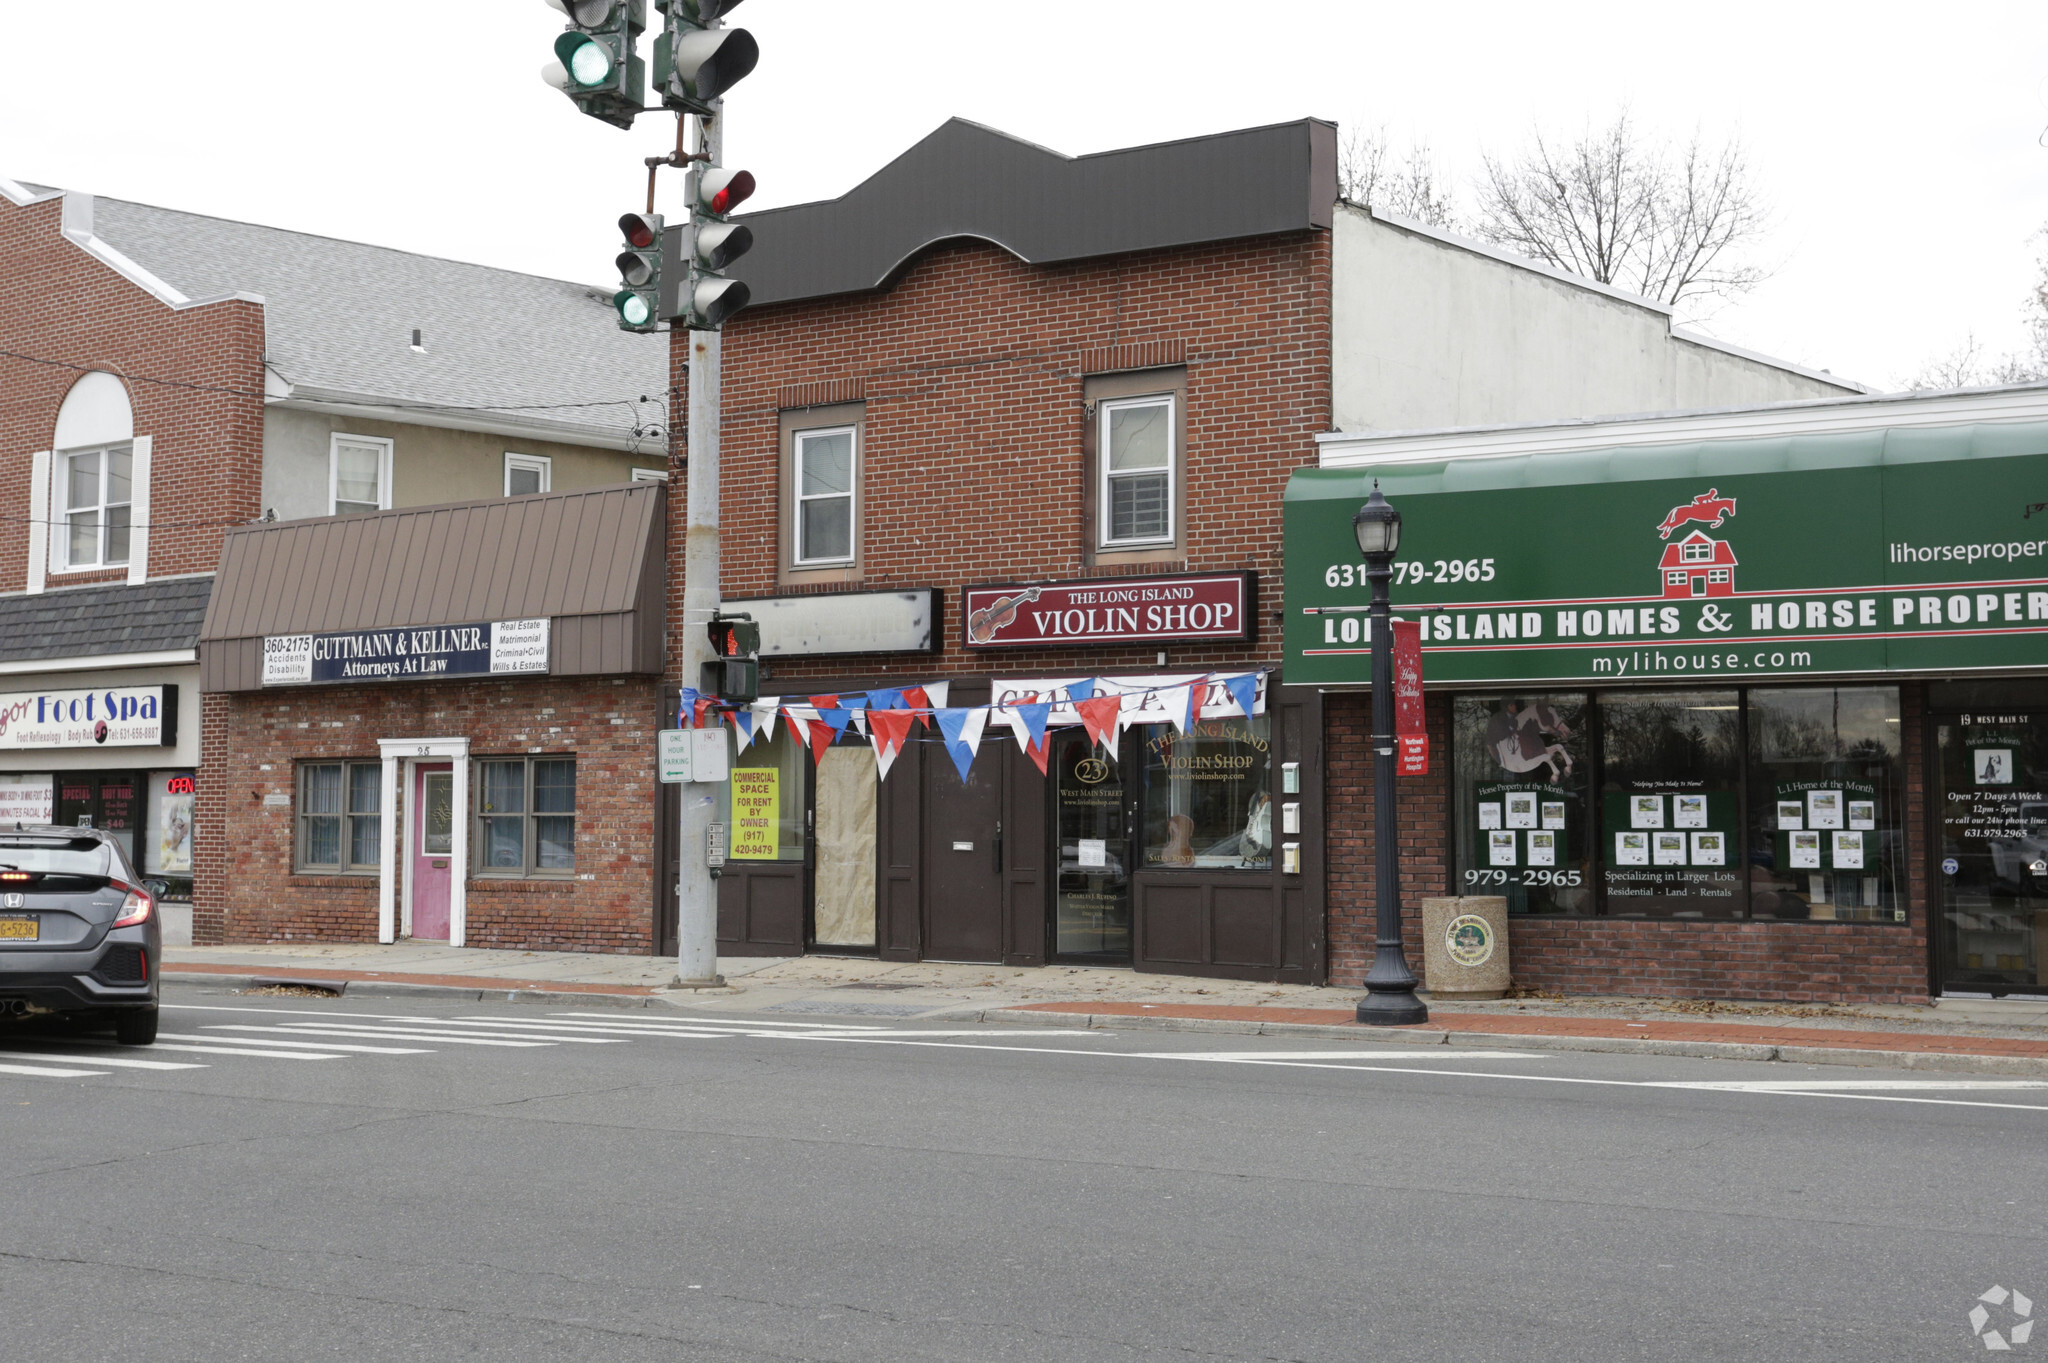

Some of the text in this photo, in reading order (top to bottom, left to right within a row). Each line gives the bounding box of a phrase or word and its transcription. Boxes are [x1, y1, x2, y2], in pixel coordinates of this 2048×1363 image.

[1890, 541, 2048, 564] lihorseproper
[1325, 558, 1496, 588] 63179-2965
[1068, 587, 1194, 605] THE LONG ISLAND
[1032, 603, 1233, 636] VIOLIN SHOP
[1420, 612, 1542, 641] ISLAND
[1557, 607, 1680, 636] HOMES
[1697, 604, 1733, 632] &
[1751, 599, 1877, 630] HORSE
[500, 621, 540, 631] Real Estate
[313, 634, 393, 660] GUTTMANN
[395, 632, 408, 656] &
[411, 628, 481, 654] KELLNER
[499, 634, 541, 644] Matrimonial
[265, 637, 310, 653] 360-2175
[268, 654, 306, 663] Accidents
[1593, 651, 1811, 676] mylihouse.com
[269, 664, 305, 674] Disability
[342, 656, 448, 678] Attorneys At Law
[492, 660, 547, 671] Wills & Estates
[1400, 666, 1417, 684] Happy
[37, 692, 96, 723] Foot
[104, 691, 157, 721] Spa
[1960, 714, 2028, 726] 19 WEST MAIN ST
[17, 732, 28, 743] Foot
[29, 729, 61, 744] Reflexology
[68, 729, 81, 743] Body
[83, 729, 93, 740] Rub
[109, 728, 119, 740] Tel:
[1146, 731, 1176, 754] THE
[1221, 722, 1268, 753] ISLAND
[417, 746, 430, 756] 25
[1160, 753, 1253, 769] VIOLIN SHOP
[1081, 762, 1102, 780] 23
[1168, 771, 1245, 781] www.liviolinshop.com
[734, 772, 775, 783] COMMERCIAL
[167, 777, 194, 793] OPEN
[740, 785, 769, 793] SPACE
[1479, 782, 1564, 796] Horse Property of the Month
[1792, 781, 1817, 791] Home
[1820, 780, 1827, 788] of
[1830, 780, 1843, 789] the
[1845, 781, 1874, 793] Month
[62, 788, 90, 800] SPECIAL
[1060, 789, 1079, 797] WEST
[1080, 789, 1098, 797] MAIN
[1948, 792, 2042, 802] Open 7 Days A Week
[737, 798, 772, 806] FOR RENT
[749, 808, 761, 816] BY
[1972, 805, 1994, 814] 12pm
[2000, 805, 2018, 814] 5pm
[107, 819, 124, 829] $40
[740, 818, 769, 828] OWNER
[2005, 817, 2028, 826] phone
[743, 831, 764, 842] (917)
[1964, 829, 2028, 838] 631.979.2965
[735, 845, 773, 854] 420-9479
[1605, 871, 1736, 884] Specializing in Larger Lots
[1607, 887, 1653, 896] Residential
[1665, 888, 1687, 896] Land
[1700, 888, 1732, 896] Rentals
